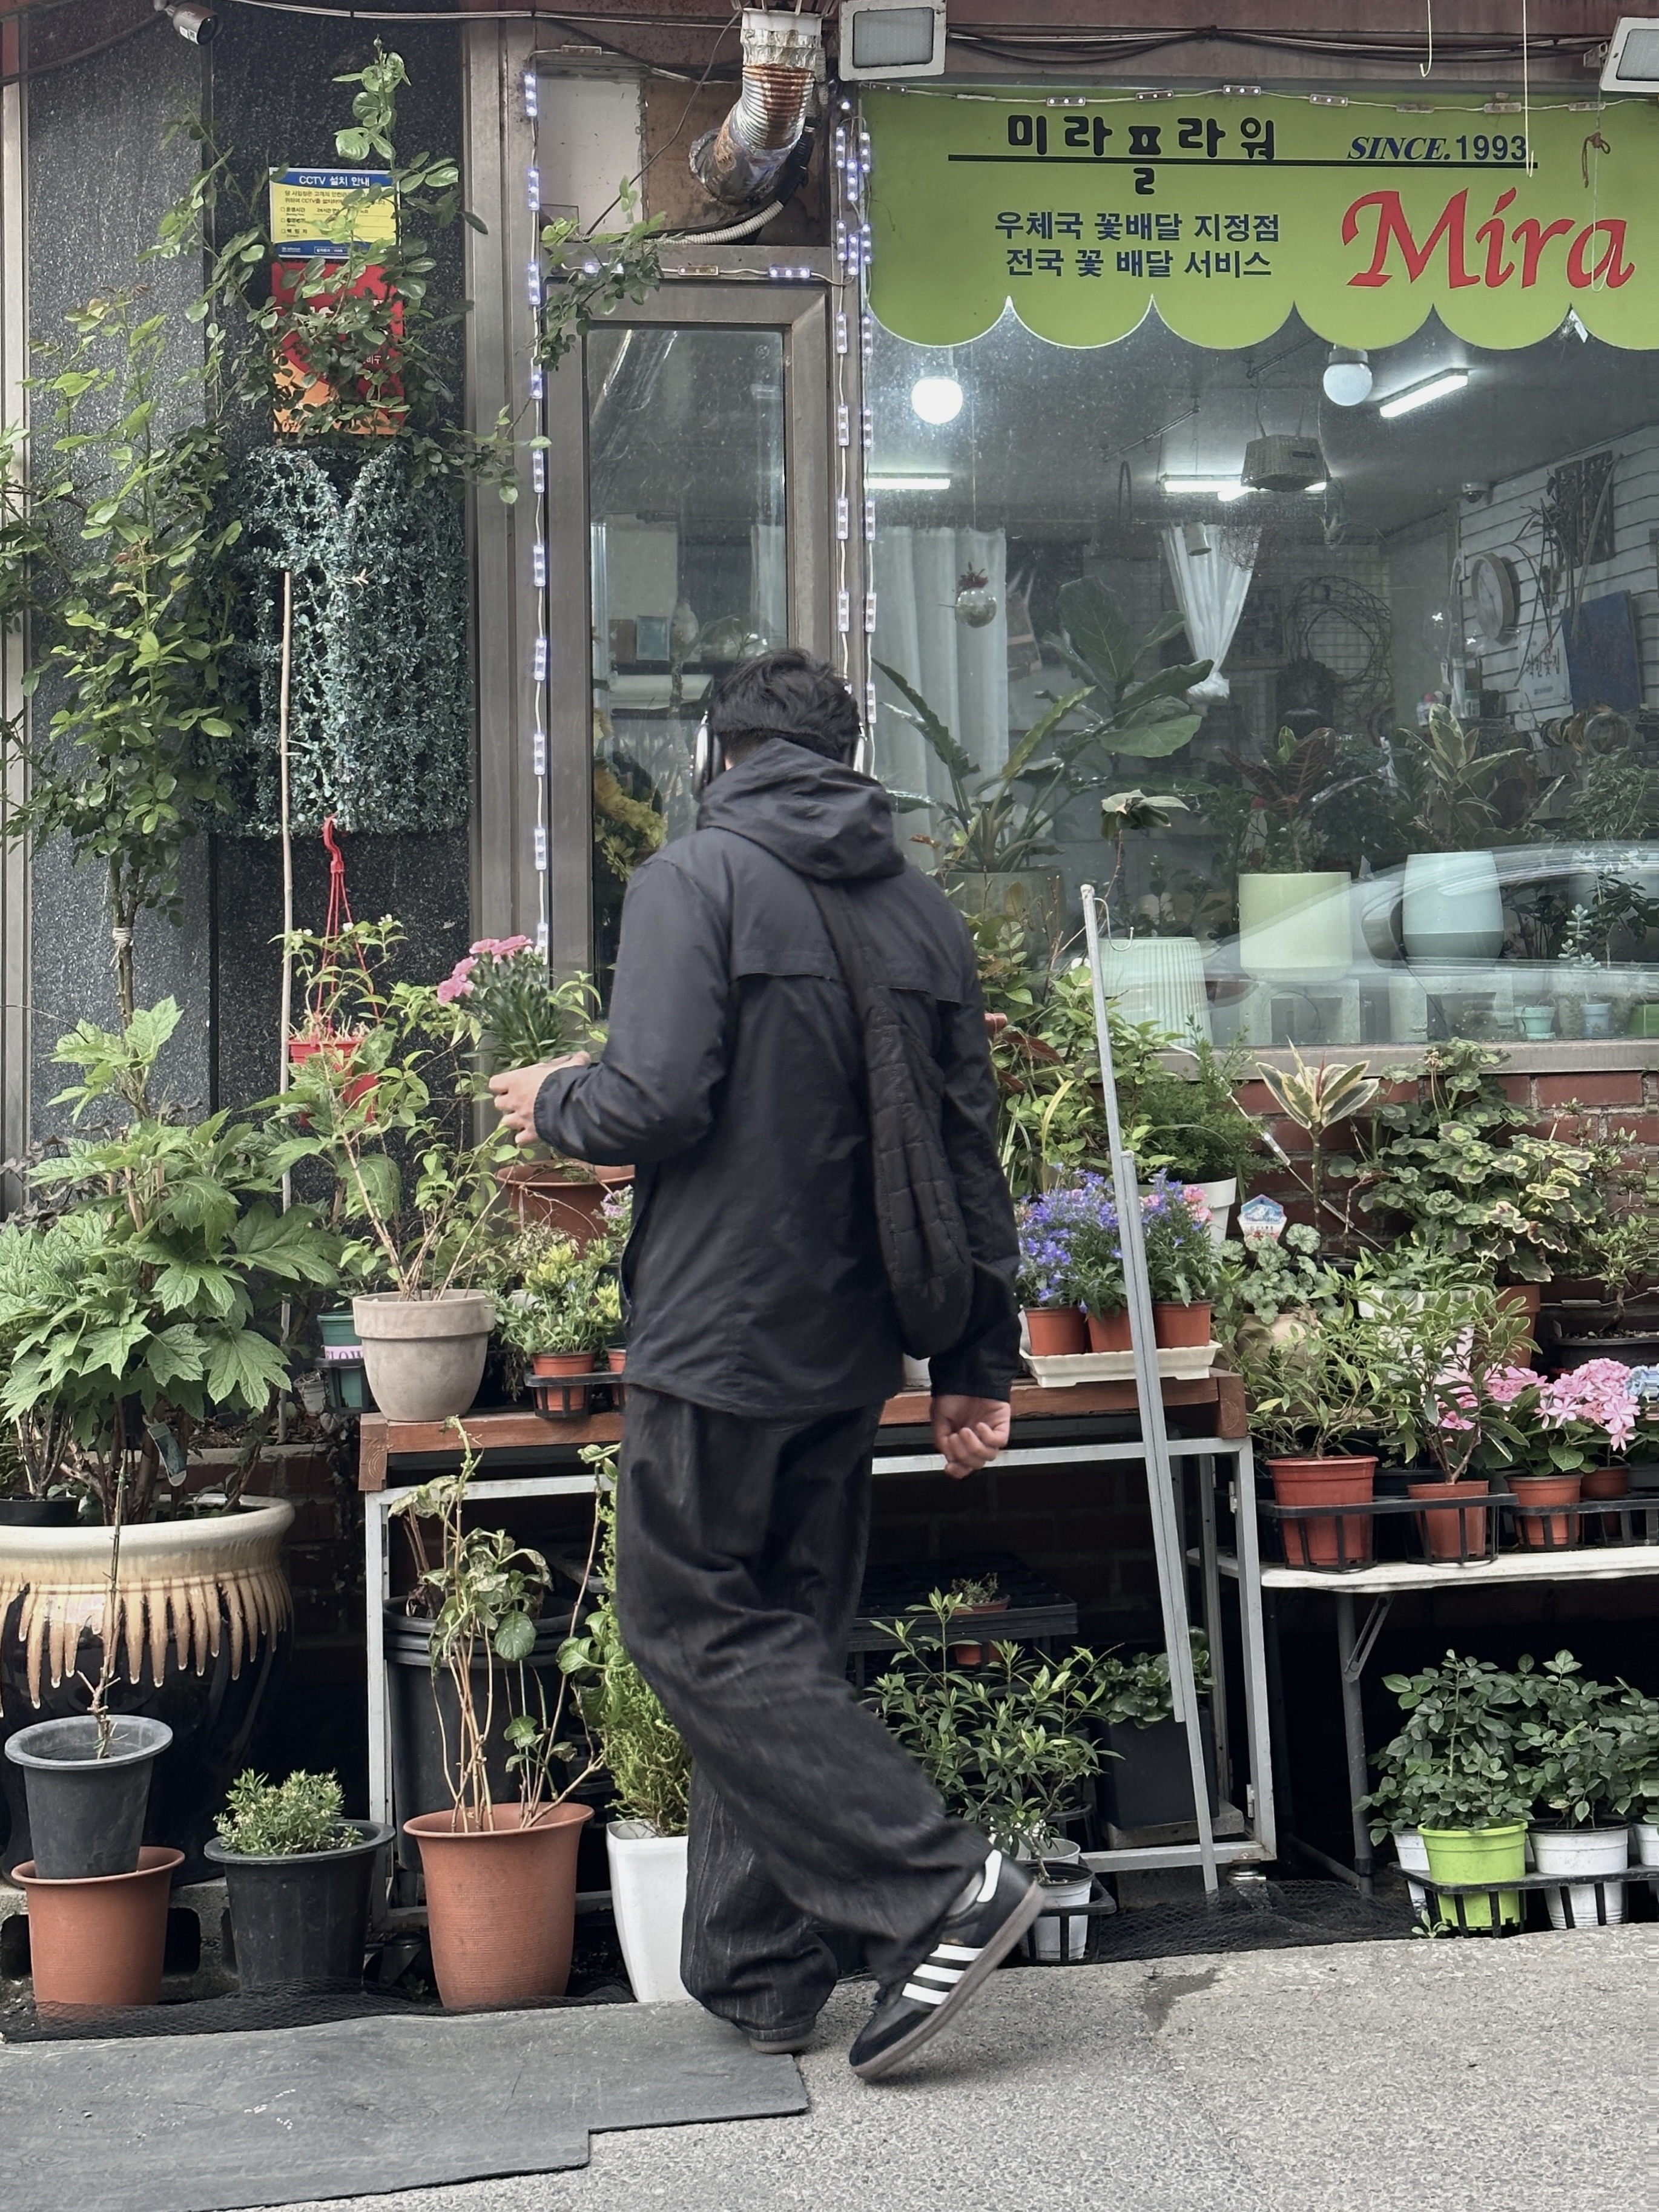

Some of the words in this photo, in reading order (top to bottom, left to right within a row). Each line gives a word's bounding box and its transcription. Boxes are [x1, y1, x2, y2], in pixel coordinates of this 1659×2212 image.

[299, 176, 326, 185] CCTV
[329, 176, 349, 186] 설치
[351, 177, 371, 187] 안내
[995, 211, 1084, 240] 우체국
[1094, 212, 1182, 242] 꽃배달
[1194, 214, 1279, 242] 지정점
[1006, 249, 1064, 276] 전국
[1075, 249, 1104, 277] 꽃
[1116, 249, 1173, 278] 배달
[1184, 250, 1271, 278] 서비스
